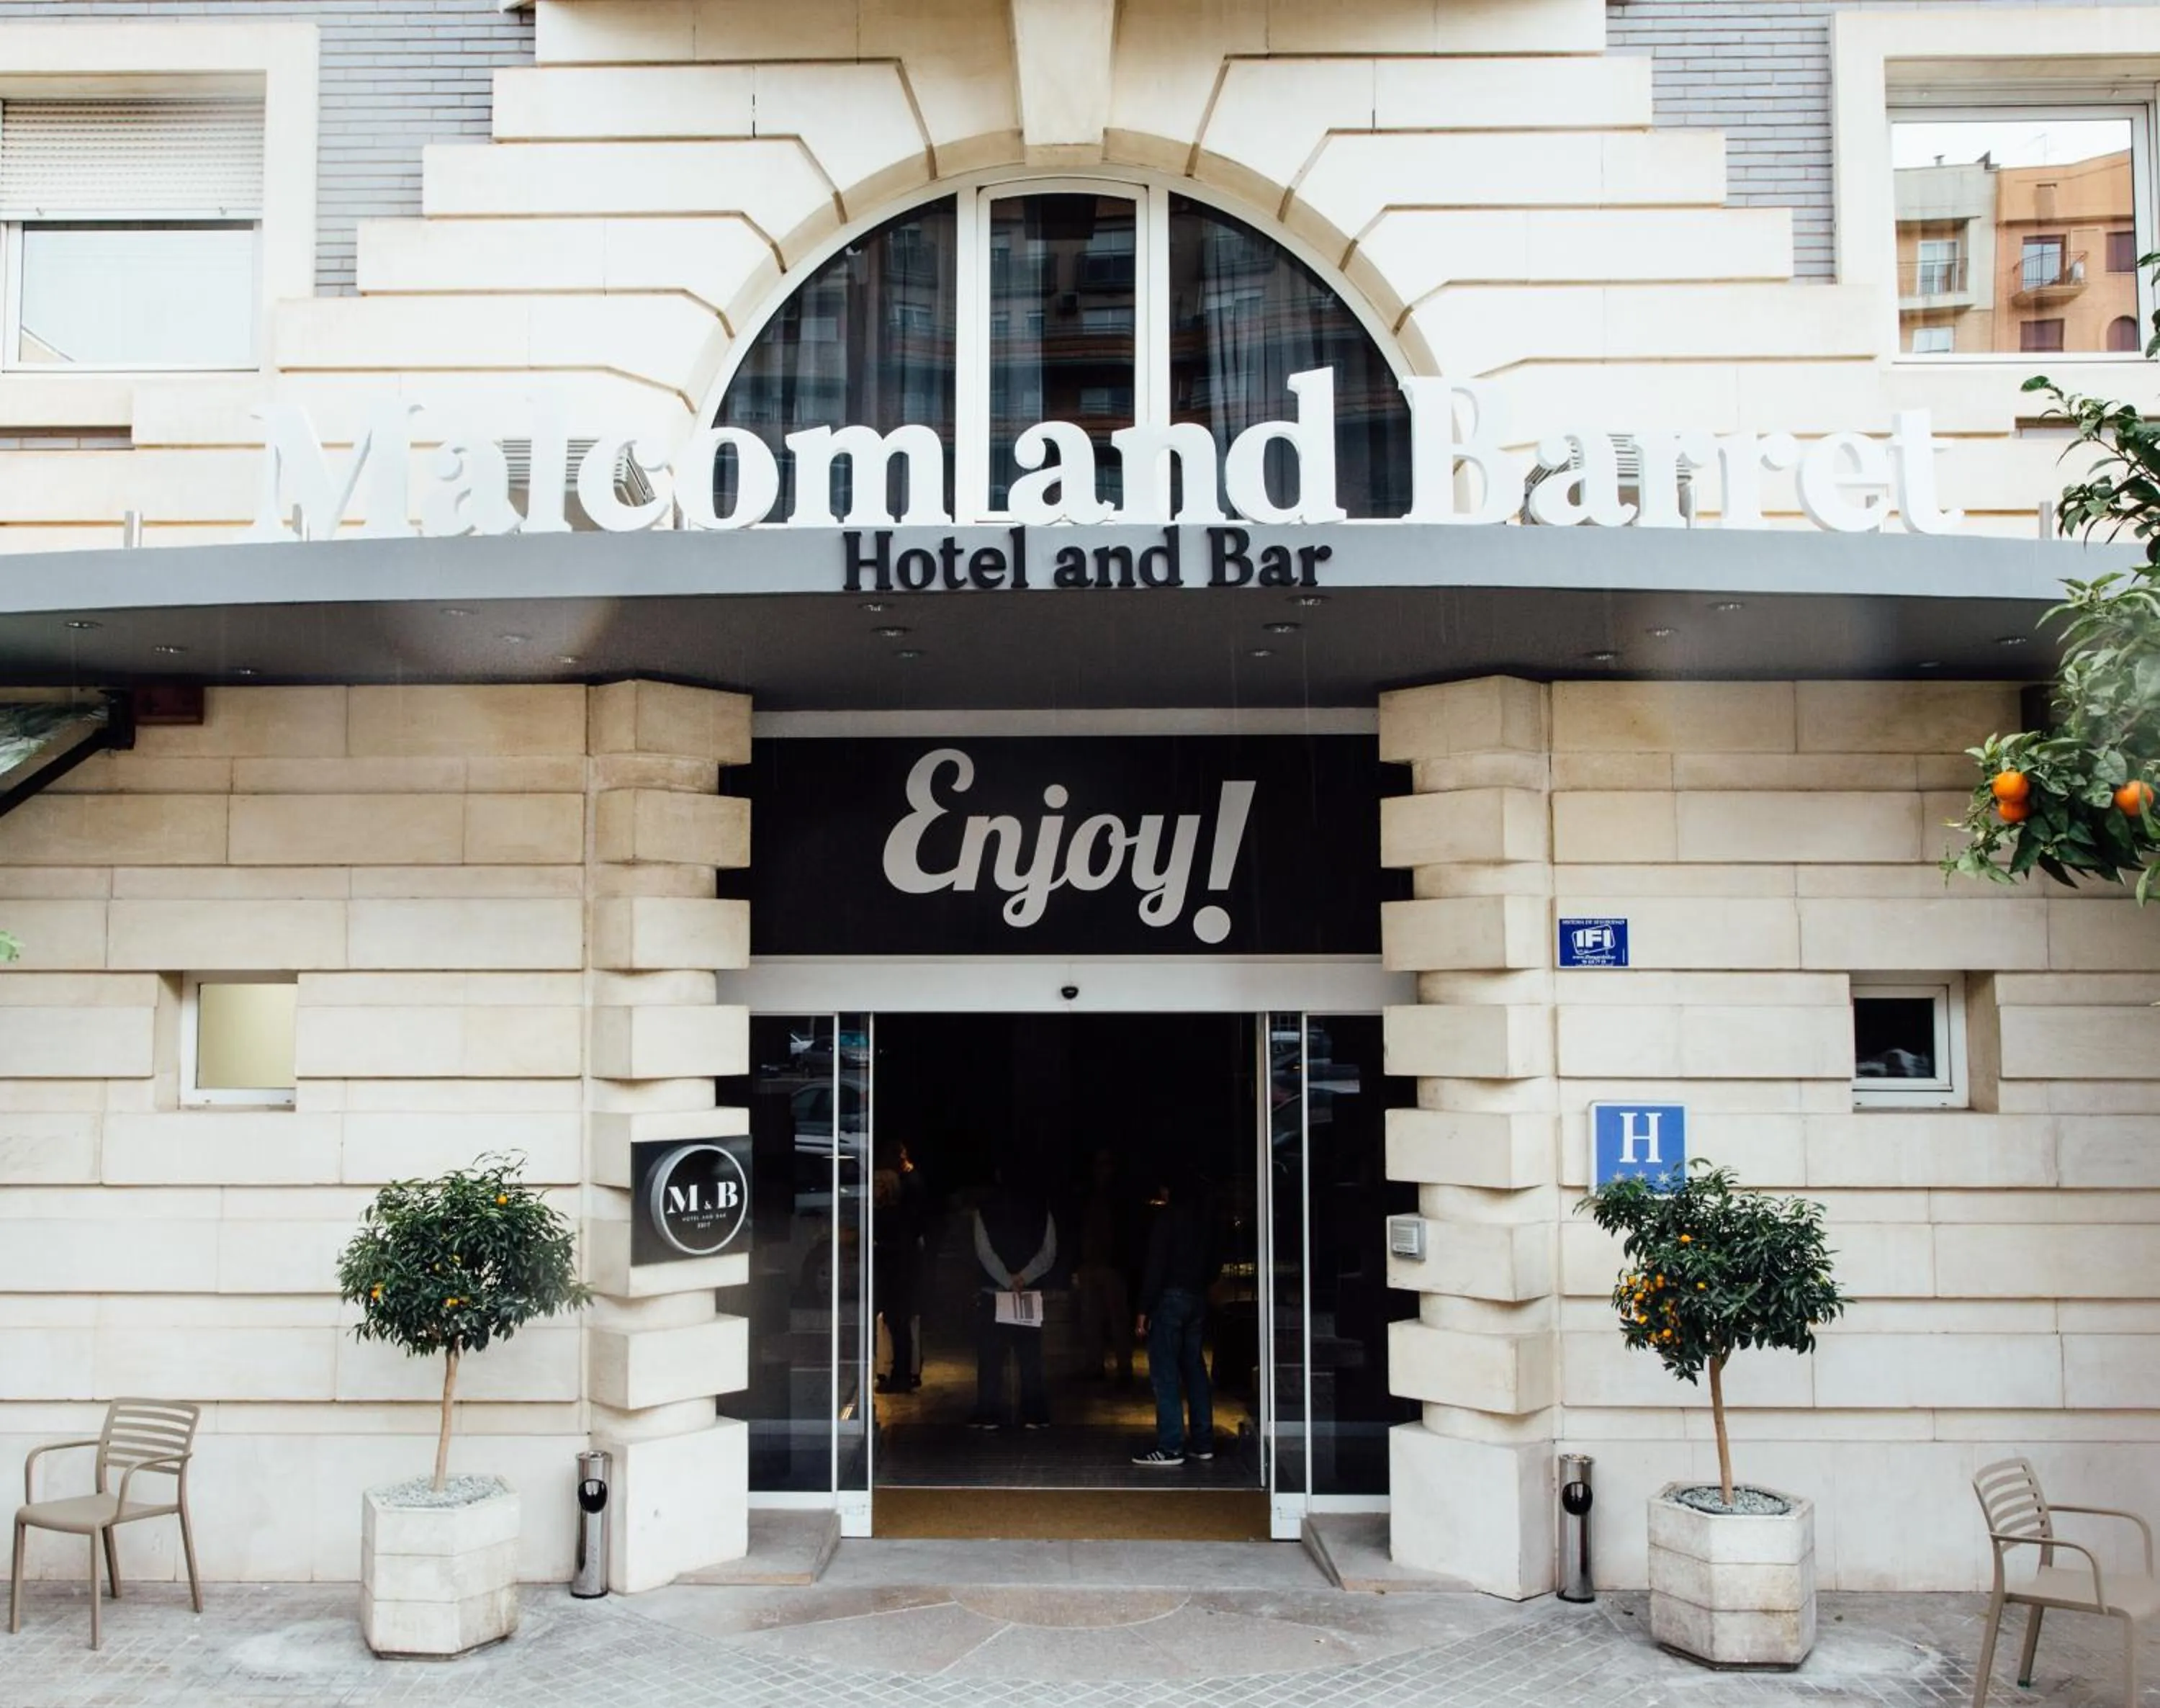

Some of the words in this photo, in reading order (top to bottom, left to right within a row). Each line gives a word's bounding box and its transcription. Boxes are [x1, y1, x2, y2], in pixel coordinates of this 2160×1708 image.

[248, 389, 954, 544] Malcom
[1008, 367, 1347, 526] and
[1398, 375, 1963, 534] Barret
[842, 525, 1030, 592] Hotel
[1053, 525, 1184, 588] and
[1206, 526, 1332, 588] Bar
[883, 747, 1256, 944] Enjoy!
[1576, 929, 1611, 948] IFI
[1619, 1112, 1662, 1163] H
[667, 1184, 698, 1214] M
[717, 1180, 739, 1209] B
